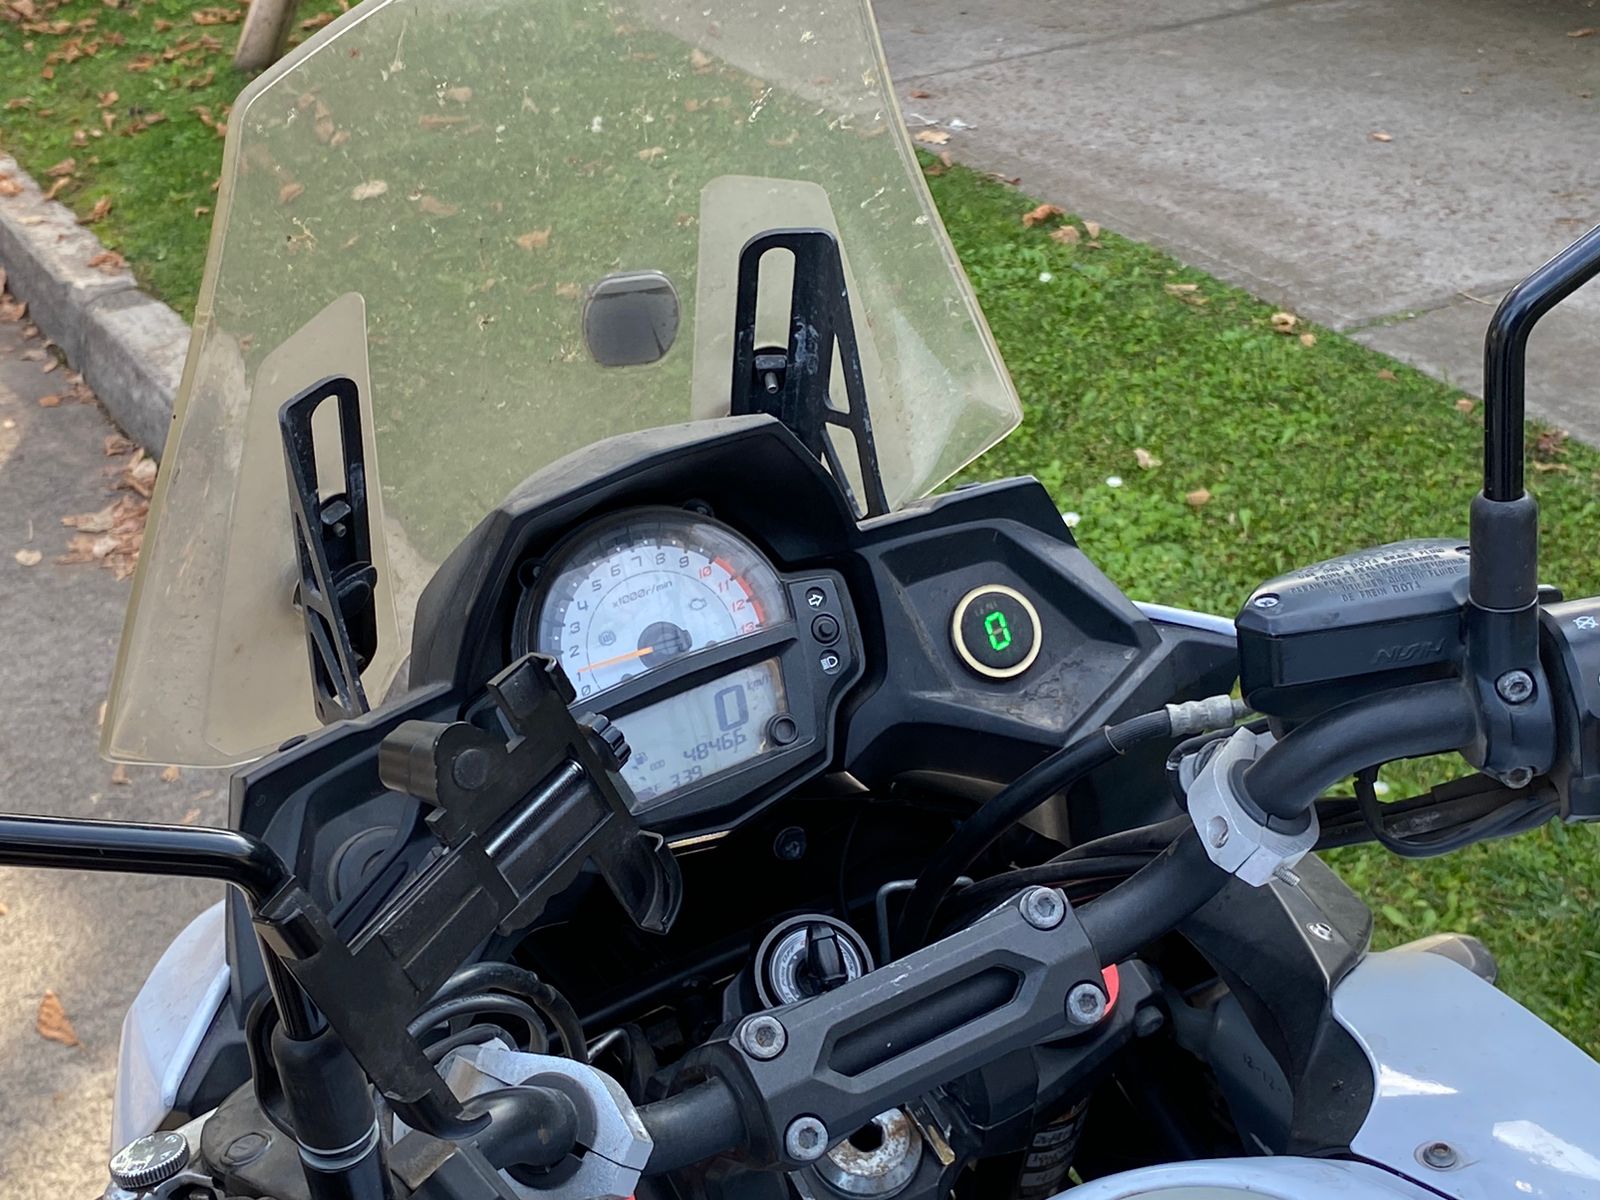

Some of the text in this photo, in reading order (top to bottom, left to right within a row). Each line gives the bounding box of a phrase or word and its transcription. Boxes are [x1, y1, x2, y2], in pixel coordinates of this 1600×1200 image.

[631, 556, 642, 567] 7
[655, 553, 665, 565] 8
[679, 556, 689, 568] 9
[611, 564, 621, 577] 6
[699, 566, 712, 579] 10
[592, 579, 602, 592] 5
[719, 580, 729, 592] 11
[577, 600, 588, 611] 4
[732, 599, 745, 612] 12
[570, 622, 580, 634] 3
[984, 611, 1012, 651] 0
[569, 645, 580, 658] 2
[714, 684, 749, 732] 0
[683, 728, 747, 761] 48466
